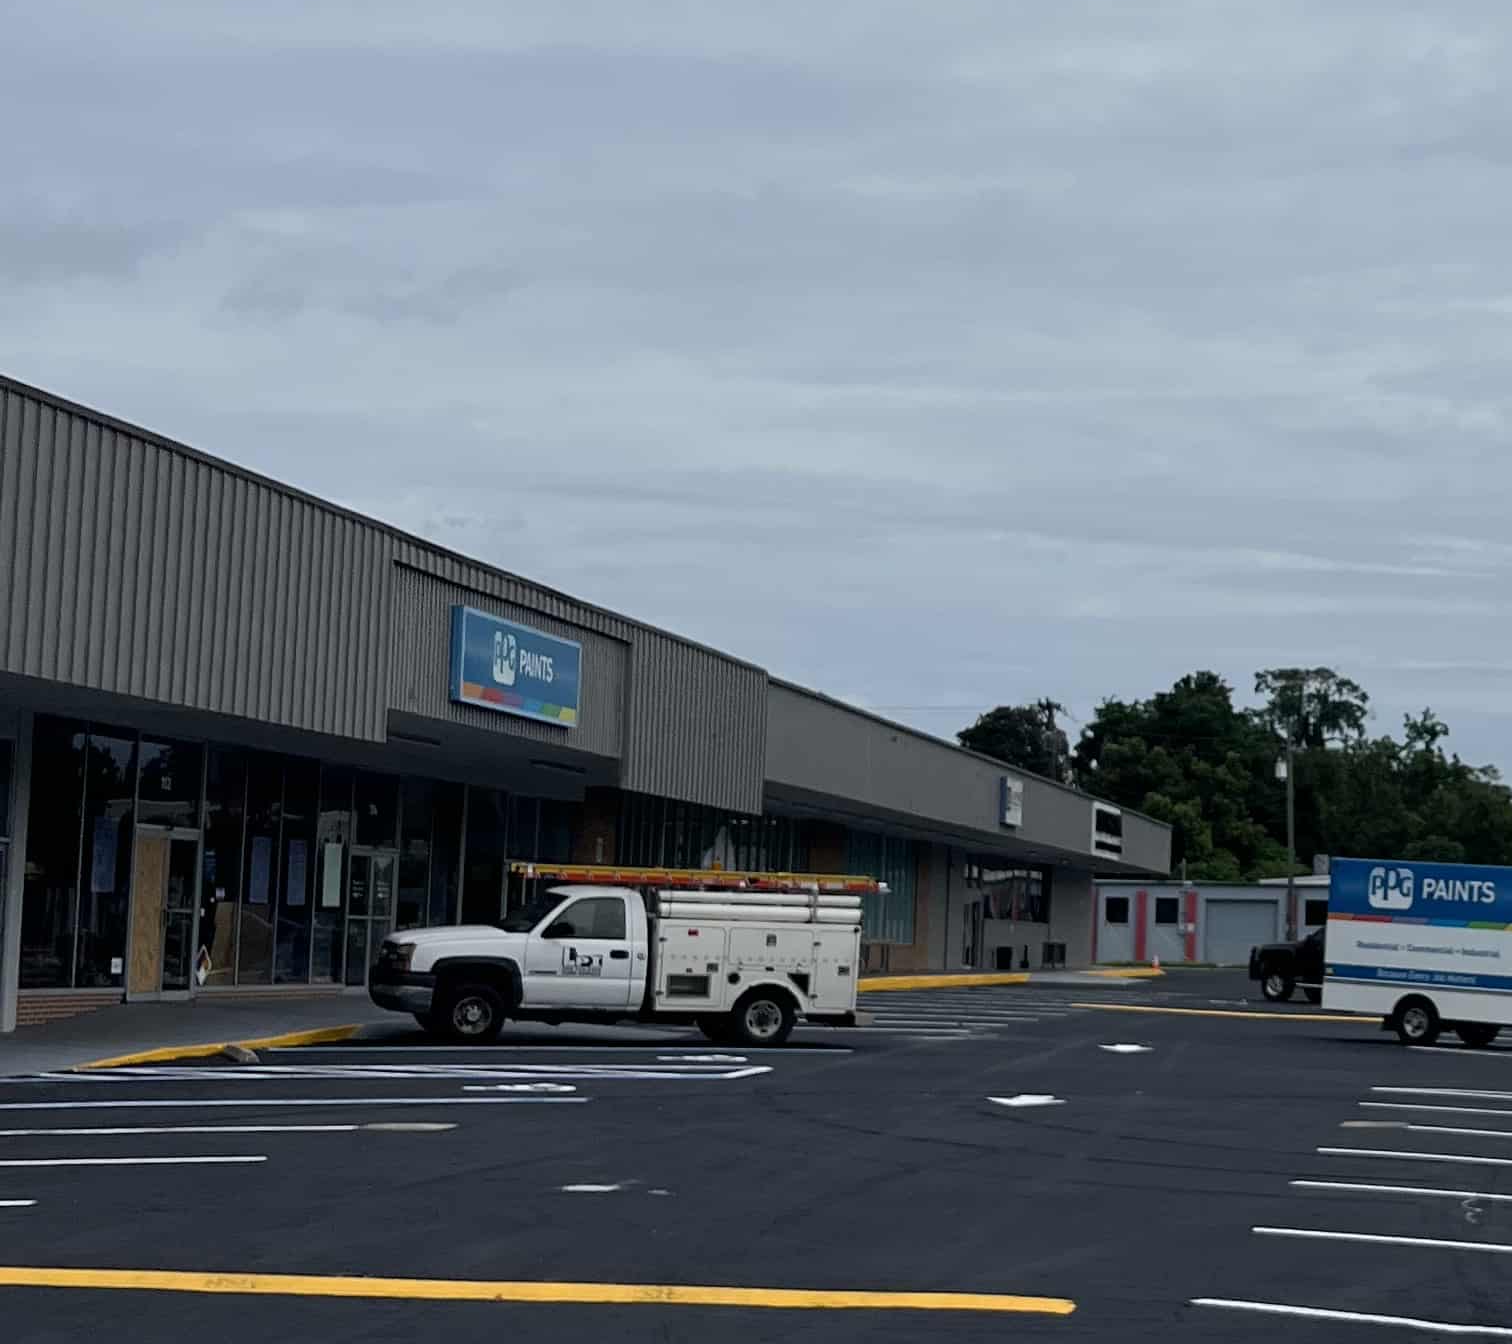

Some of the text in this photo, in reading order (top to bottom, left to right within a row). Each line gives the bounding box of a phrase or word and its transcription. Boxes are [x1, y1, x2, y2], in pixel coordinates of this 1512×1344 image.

[519, 649, 553, 683] PAINTS
[1369, 866, 1496, 907] PPG PAINTS
